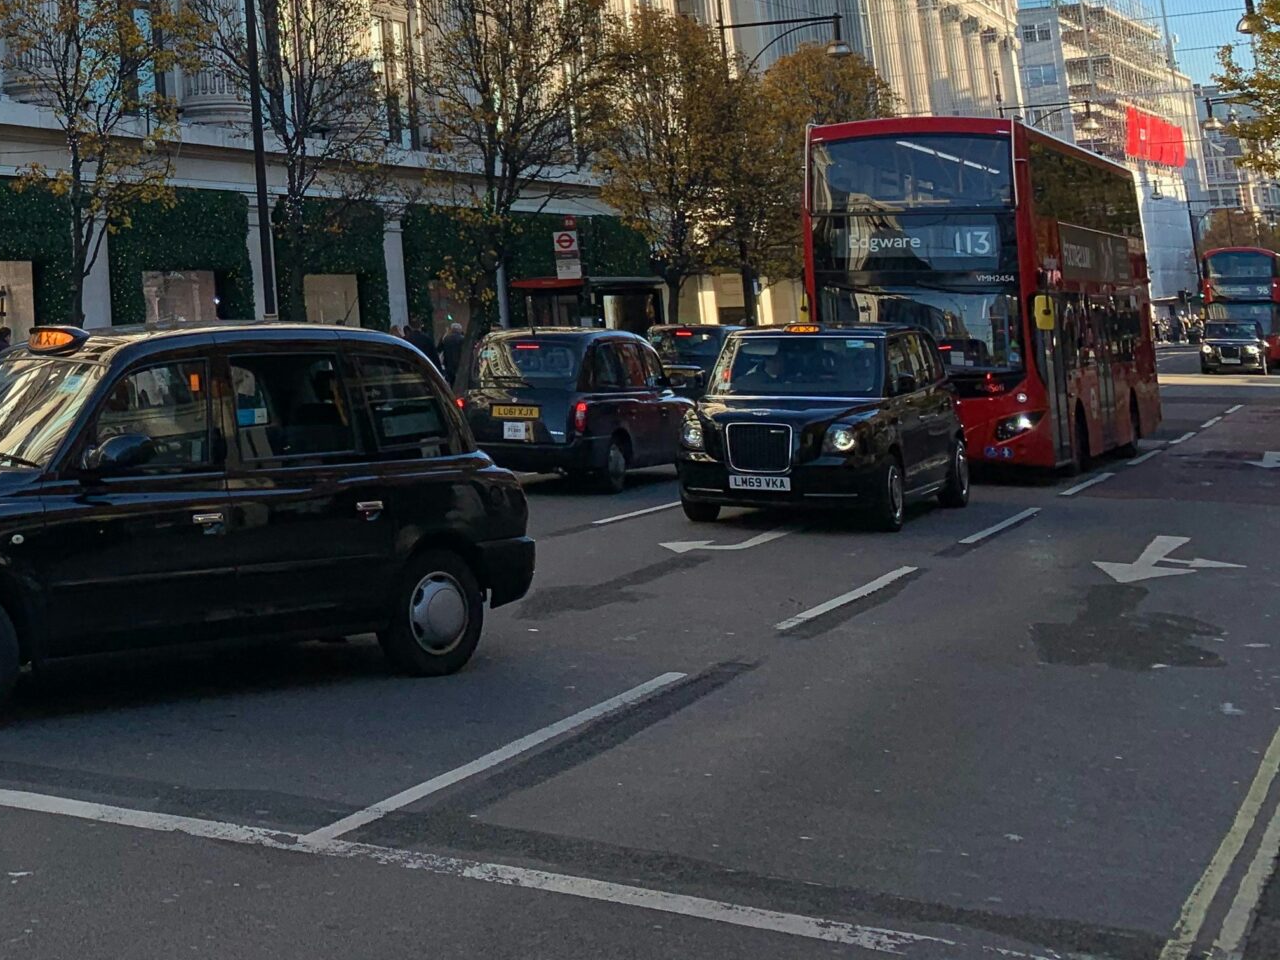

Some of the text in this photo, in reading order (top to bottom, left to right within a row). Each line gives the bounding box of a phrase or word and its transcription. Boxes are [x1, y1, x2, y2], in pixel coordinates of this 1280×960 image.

[848, 231, 991, 255] Edgware 113
[975, 274, 1015, 283] VMH2454
[517, 409, 534, 417] XJX
[734, 477, 786, 489] LM69 VKA
